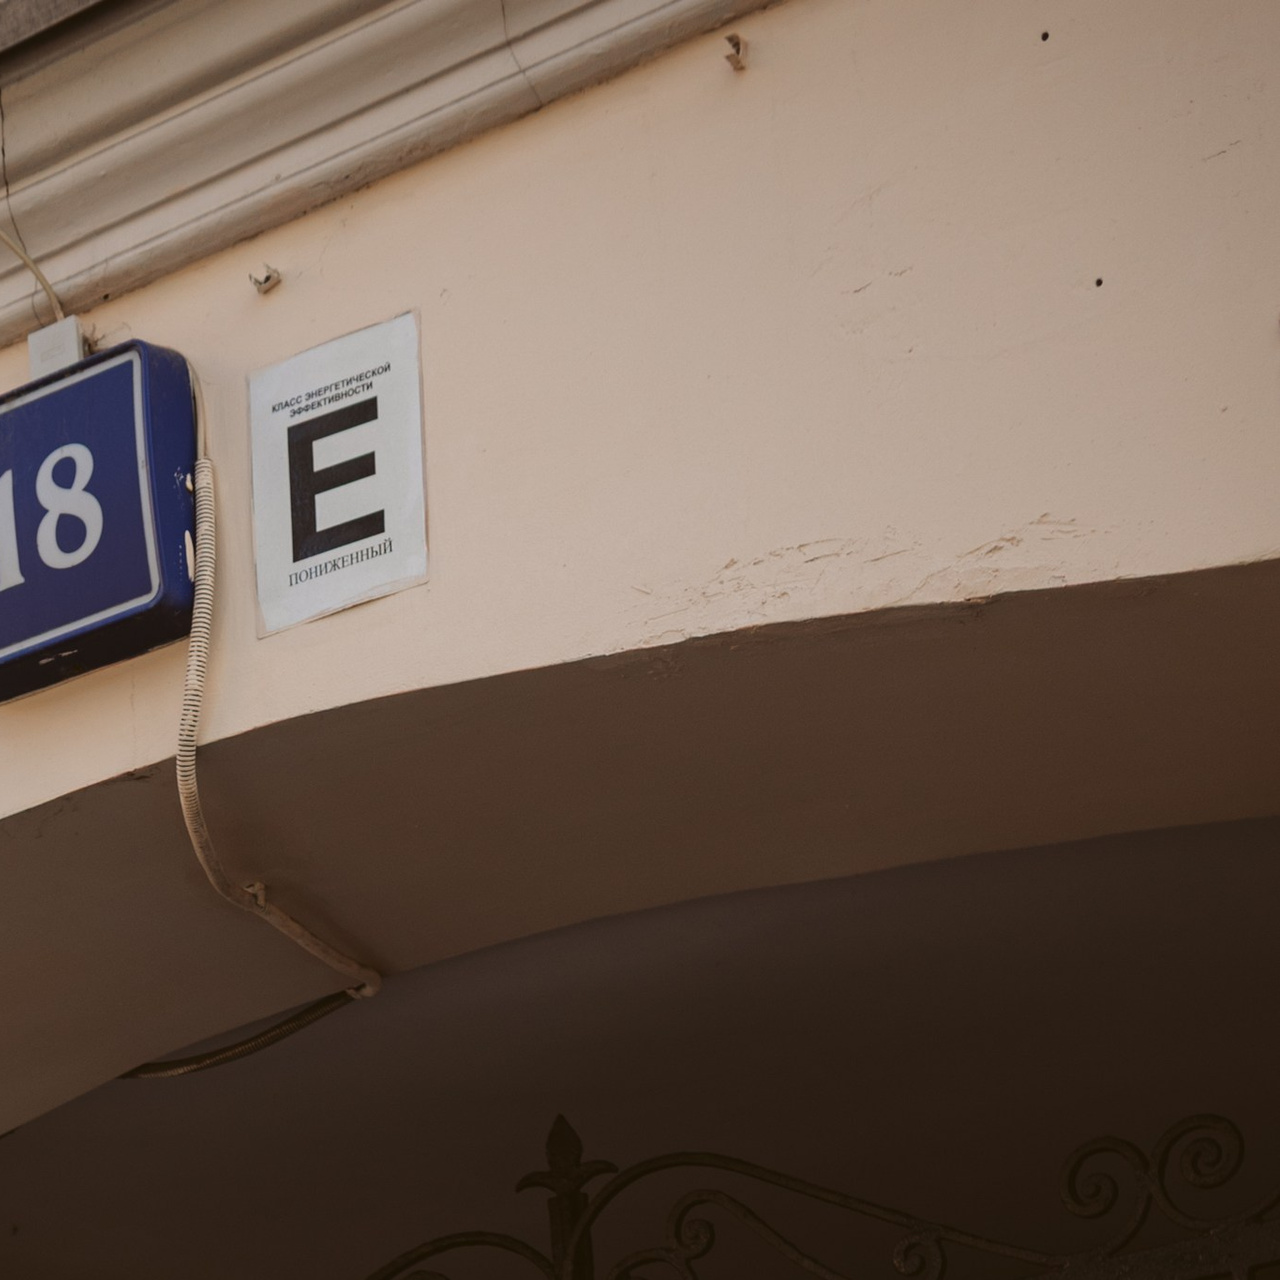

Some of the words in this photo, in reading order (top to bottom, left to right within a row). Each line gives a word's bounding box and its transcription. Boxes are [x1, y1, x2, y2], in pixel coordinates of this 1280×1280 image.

[272, 396, 302, 413] КЛАСС
[305, 361, 391, 401] ЭНЕРГЕТИЧЕСКОЙ
[289, 381, 373, 418] ЭФФЕКТИВНОСТИ
[287, 395, 385, 563] Е
[288, 537, 393, 587] ПОНИЖЕННЫЙ
